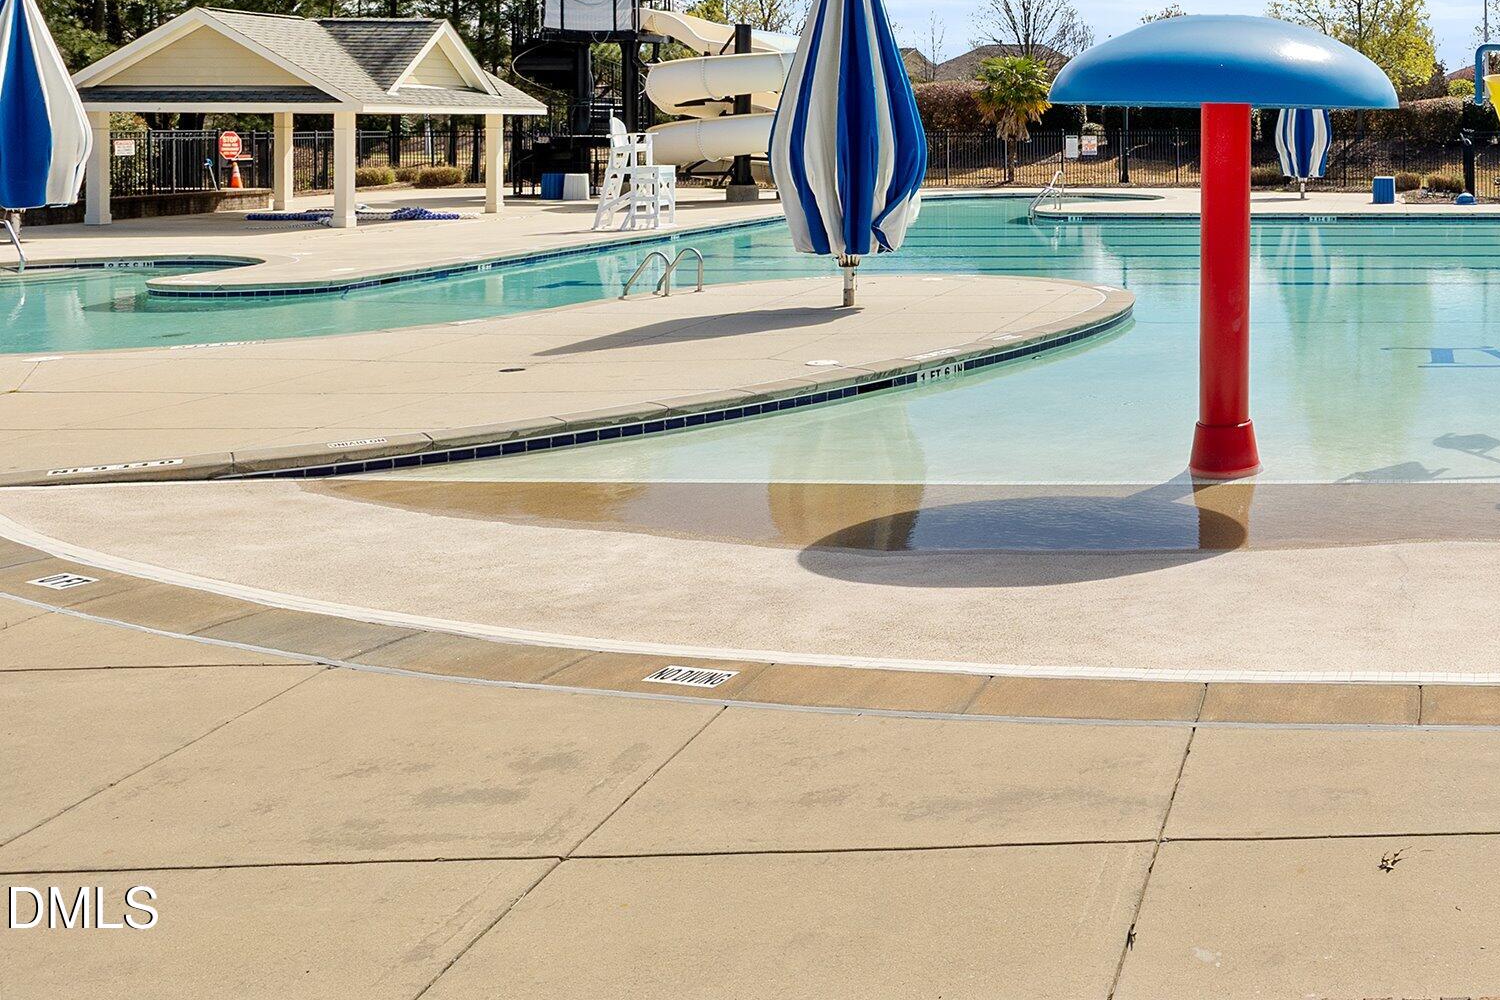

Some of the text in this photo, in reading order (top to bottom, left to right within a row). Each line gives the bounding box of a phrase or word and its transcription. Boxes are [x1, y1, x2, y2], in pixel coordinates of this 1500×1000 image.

[930, 369, 941, 380] FT
[954, 363, 964, 374] IN
[50, 577, 92, 588] FT
[648, 667, 732, 685] NO DIVING
